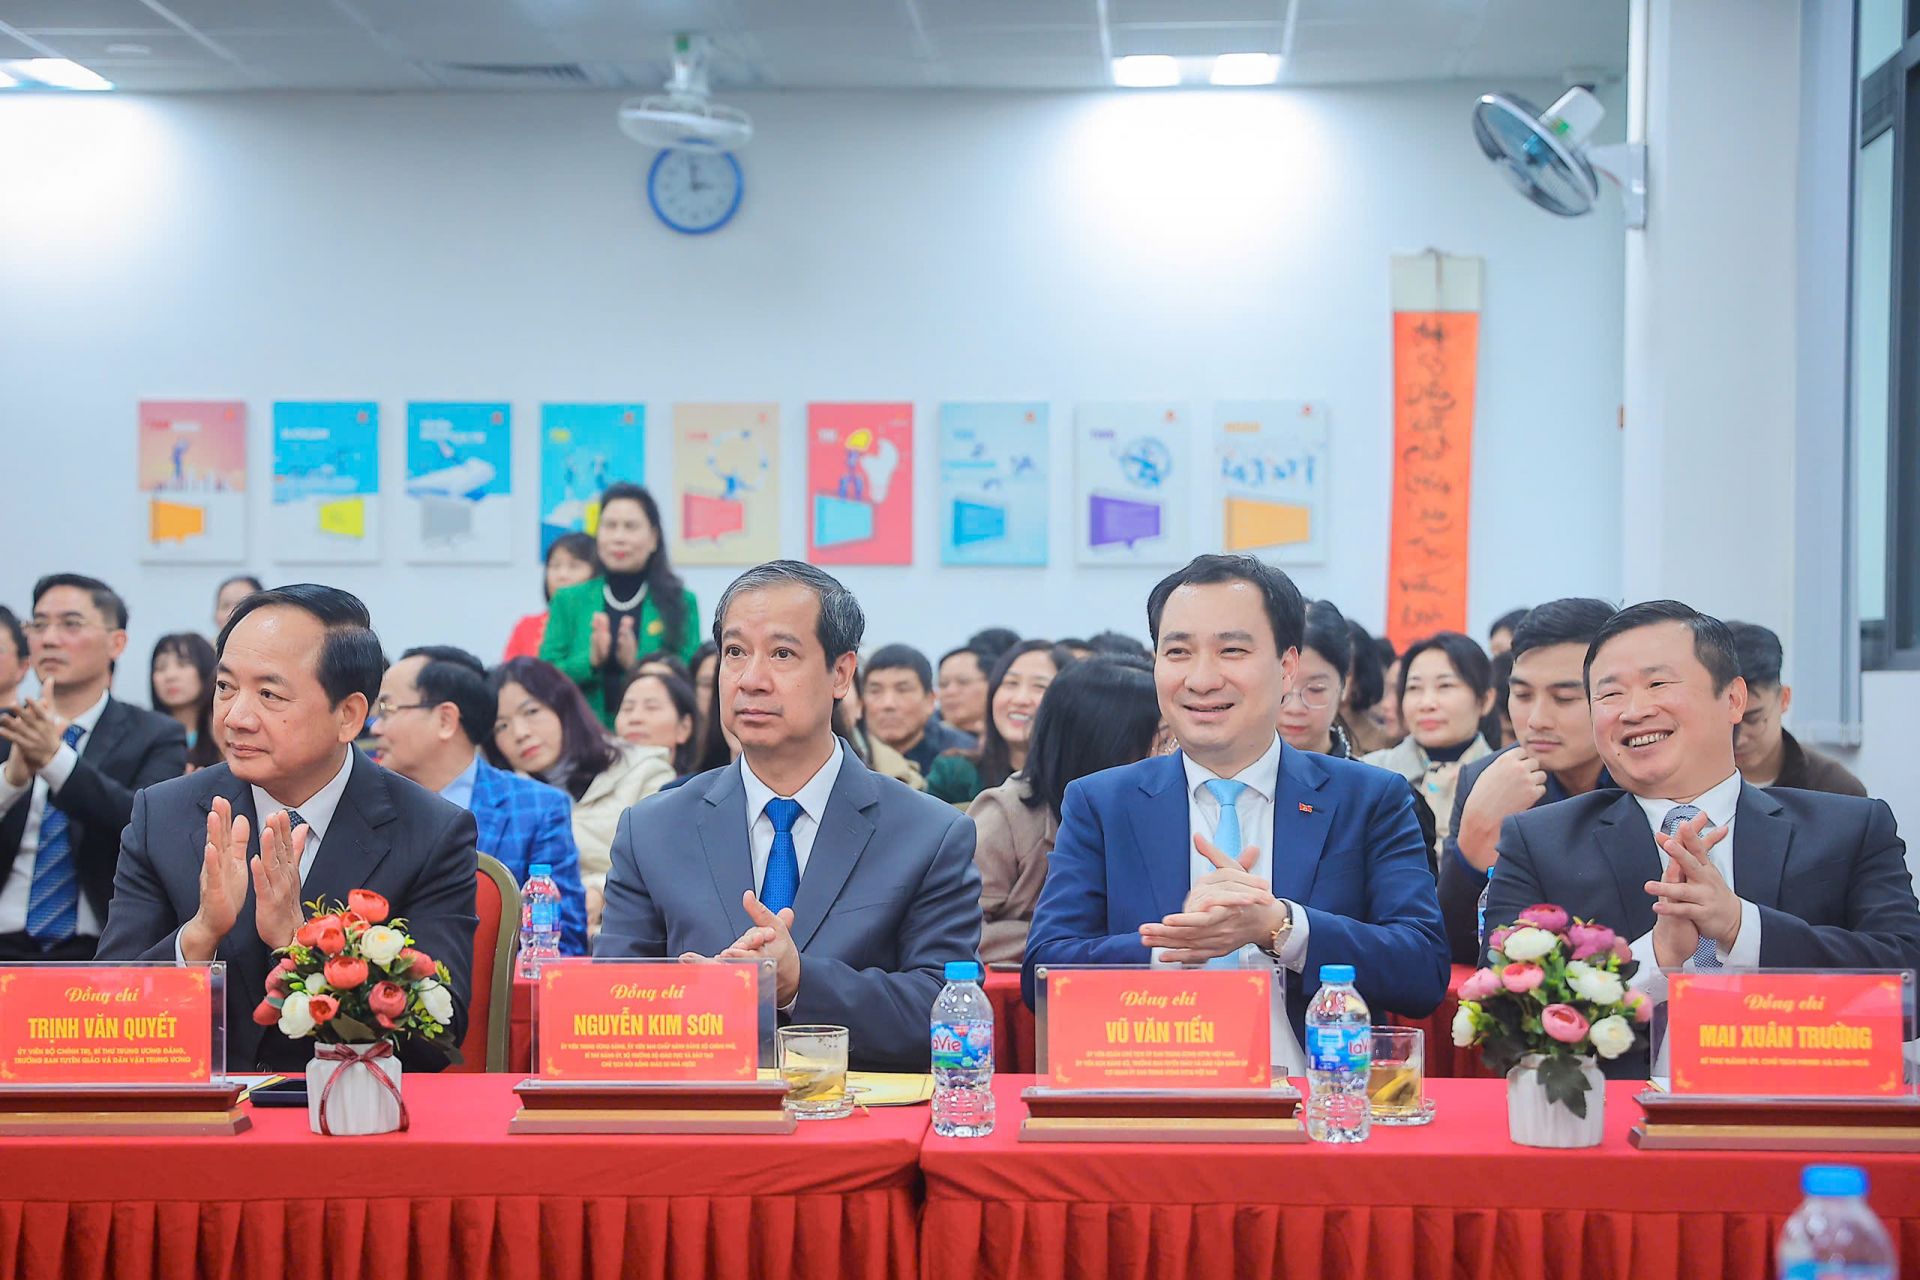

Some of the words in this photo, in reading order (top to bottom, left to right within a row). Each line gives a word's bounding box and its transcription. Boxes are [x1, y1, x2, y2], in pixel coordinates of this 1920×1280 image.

[64, 986, 110, 1004] Đồng
[114, 987, 140, 1002] chí
[610, 983, 658, 1001] Đồng
[661, 984, 687, 999] chí
[1120, 990, 1168, 1008] Đồng
[1171, 991, 1198, 1007] chí
[1798, 994, 1826, 1011] chí
[28, 1017, 79, 1043] TRỊNH
[84, 1012, 119, 1039] VĂN
[124, 1010, 177, 1040] QUYẾT
[573, 1007, 644, 1036] NGUYỄN
[648, 1014, 682, 1036] KIM
[687, 1012, 724, 1036] SƠN
[1105, 1017, 1129, 1044] VŨ
[1133, 1017, 1170, 1043] VĂN
[1174, 1015, 1215, 1043] TIẾN
[931, 1034, 962, 1052] aVie
[1700, 1024, 1736, 1048] MAI
[1741, 1021, 1793, 1049] XUÂN
[1797, 1021, 1873, 1050] TRƯỜNG
